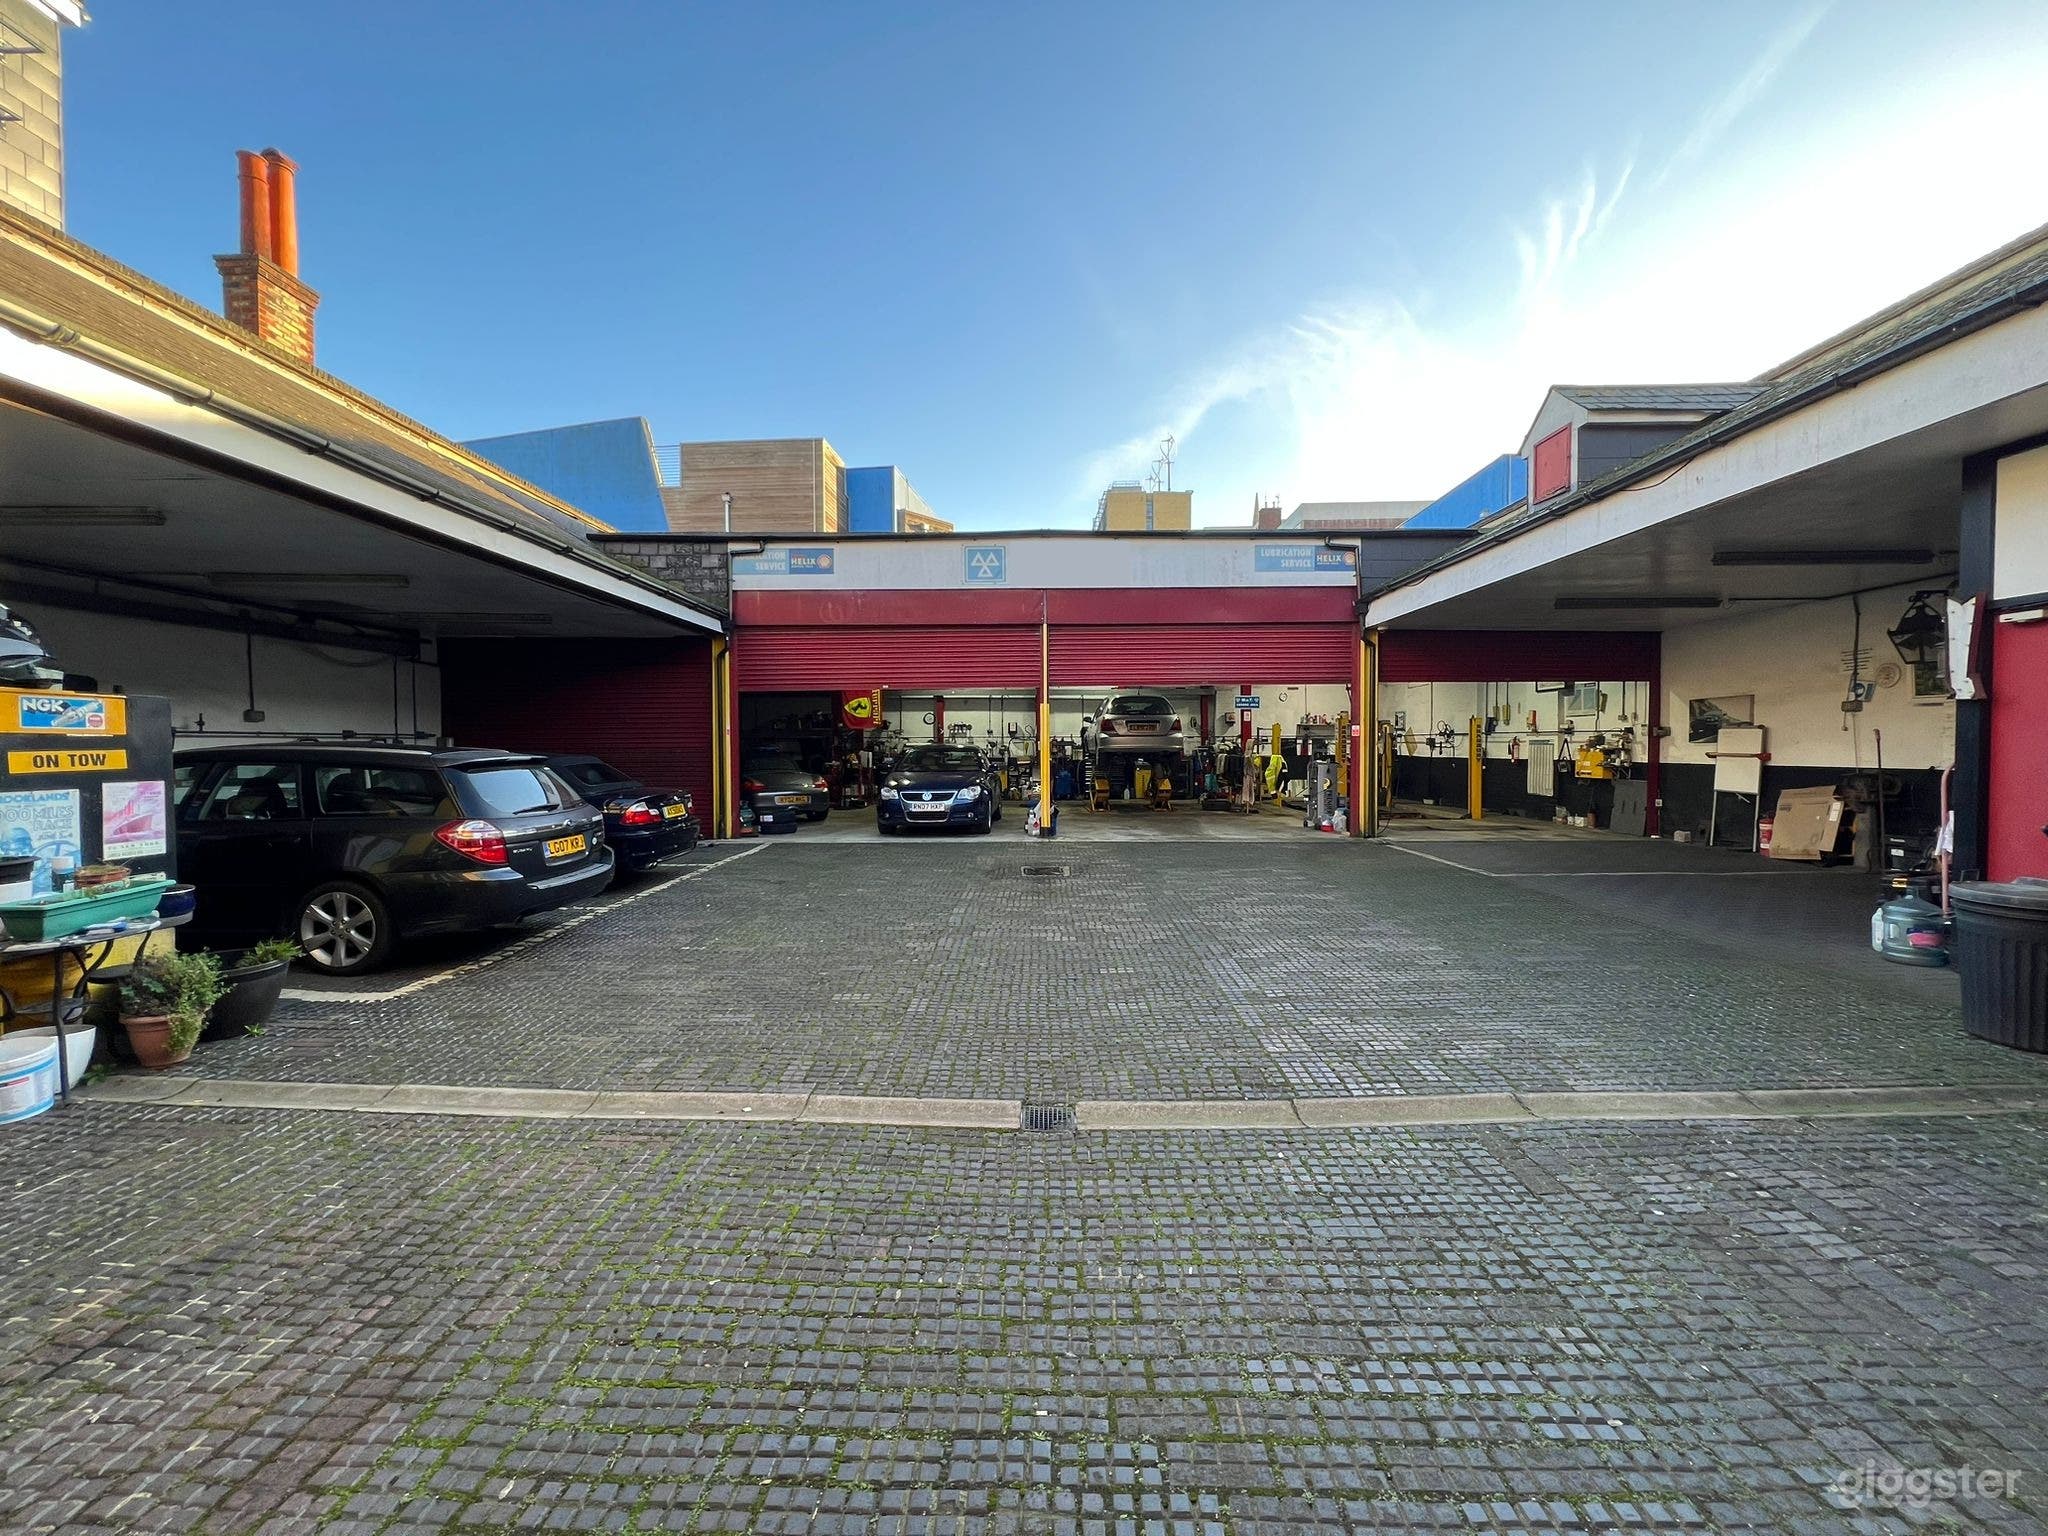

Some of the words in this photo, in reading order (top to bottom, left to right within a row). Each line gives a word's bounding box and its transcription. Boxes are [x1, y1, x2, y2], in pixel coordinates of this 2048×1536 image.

[1261, 547, 1313, 558] LUBRICATION
[1316, 554, 1342, 562] HELIX
[755, 562, 786, 571] SERVICE
[791, 557, 816, 565] HELIX
[1280, 560, 1313, 569] SERVICE
[22, 697, 65, 713] NGK
[33, 754, 59, 768] ON
[67, 753, 107, 767] TOW
[32, 805, 73, 820] MILES
[33, 819, 72, 832] RACE
[548, 839, 570, 855] LG07
